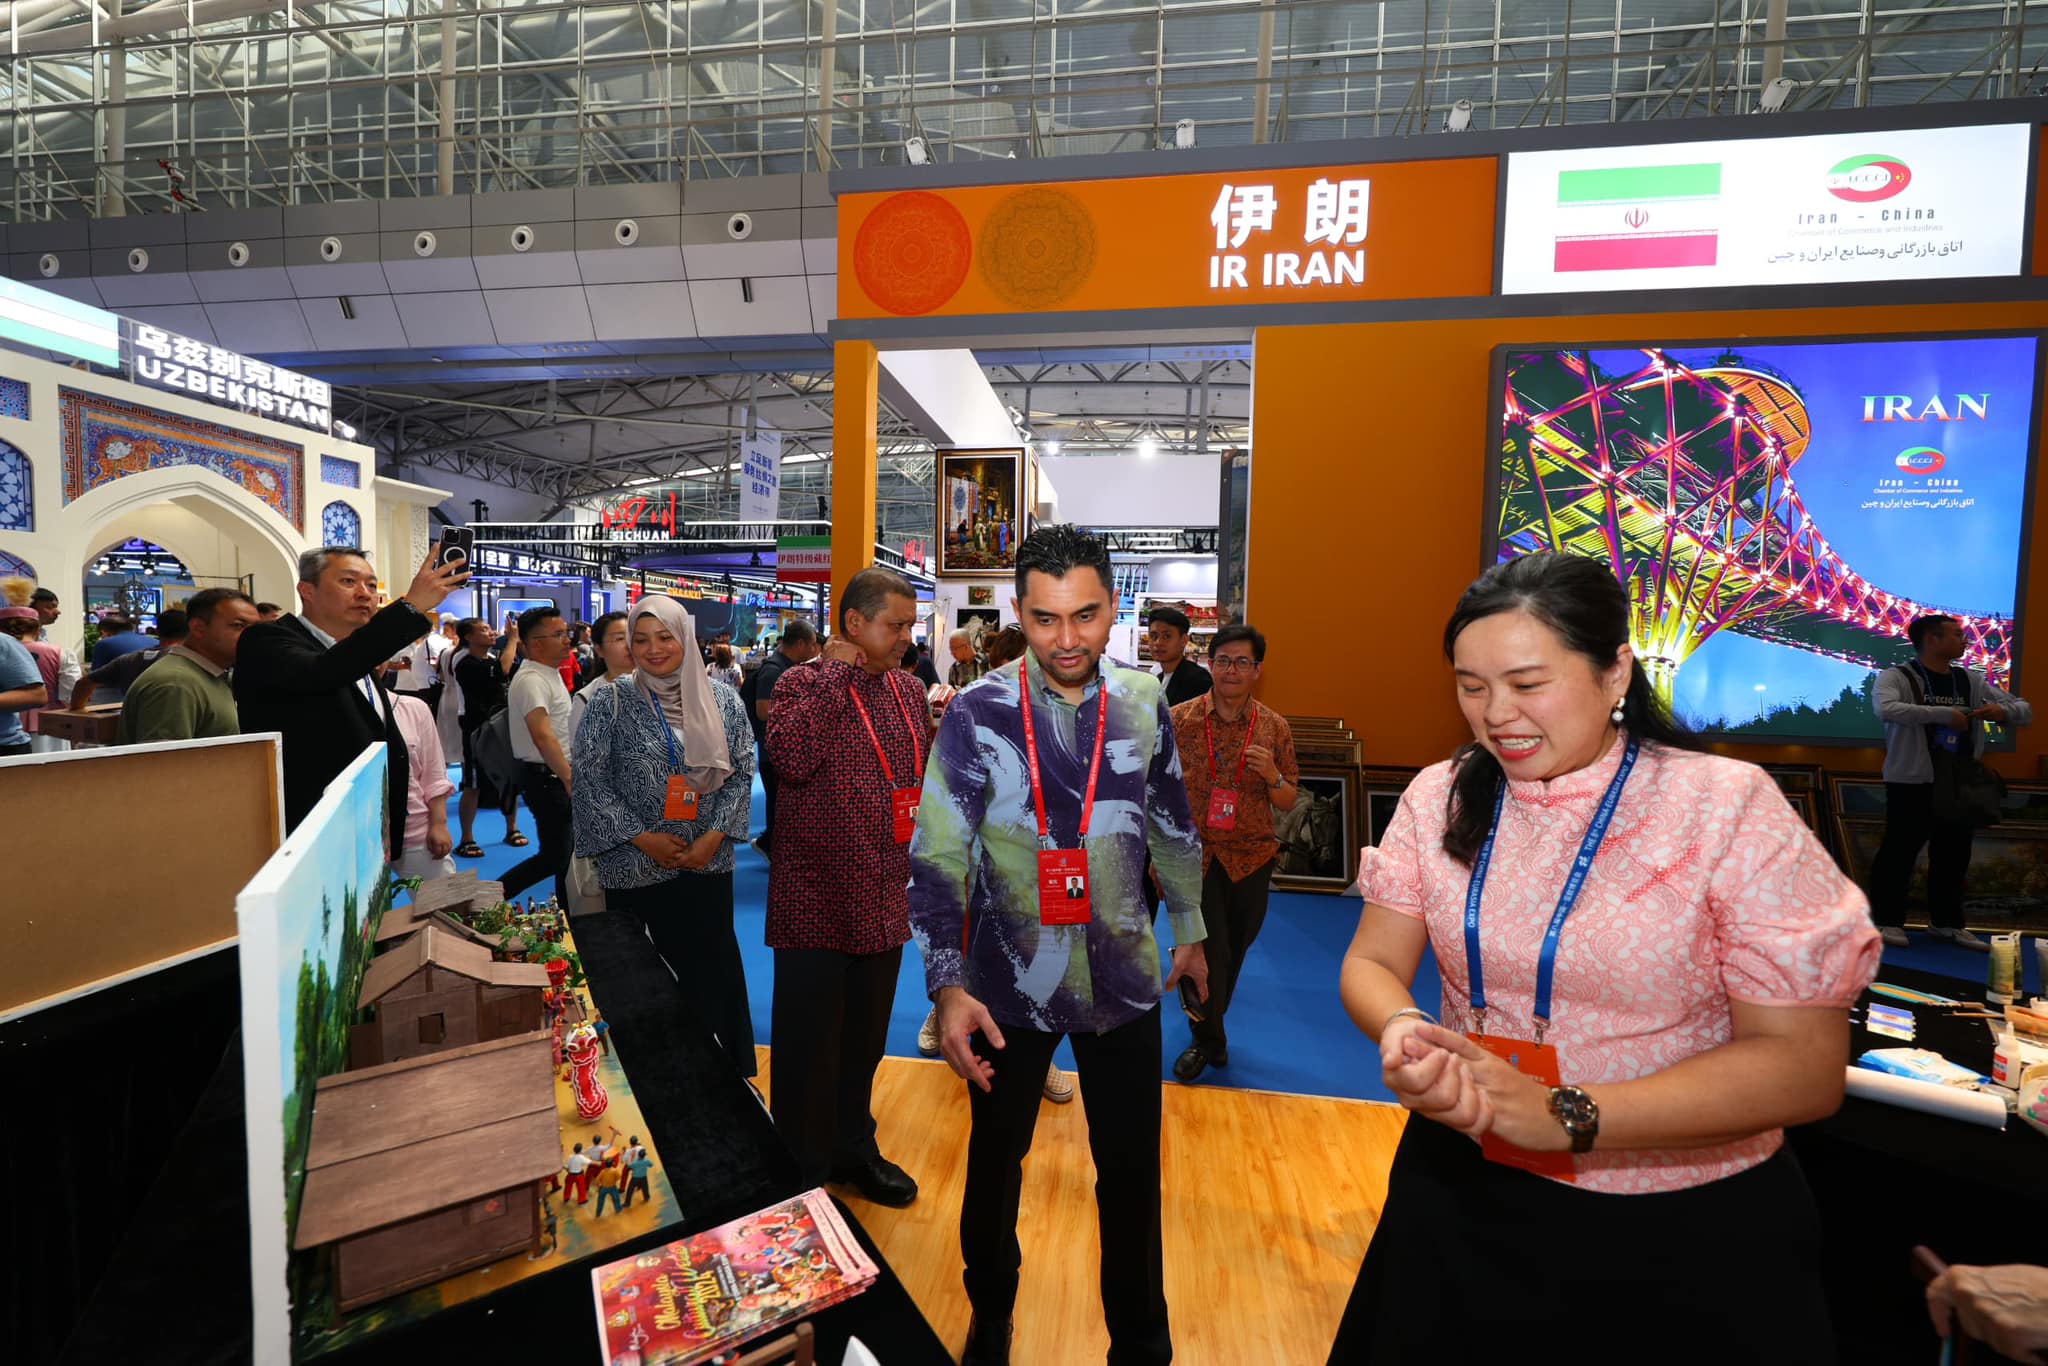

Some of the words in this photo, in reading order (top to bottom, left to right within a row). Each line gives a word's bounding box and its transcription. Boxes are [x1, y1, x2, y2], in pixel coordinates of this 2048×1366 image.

[1210, 178, 1370, 250] 伊朗
[1798, 213, 1838, 225] Iran
[1881, 208, 1935, 221] China
[1210, 255, 1248, 288] IR
[1263, 249, 1365, 287] IRAN
[135, 325, 330, 407] 乌兹别克斯坦
[138, 354, 329, 427] UZBEKISTAN
[1860, 393, 1991, 423] IRAN
[1879, 479, 1904, 487] Iran
[1927, 478, 1959, 487] China
[602, 492, 677, 537] 四川
[612, 530, 669, 541] SICHUAN
[651, 1273, 682, 1330] Malaysia
[695, 1269, 721, 1304] 2024
